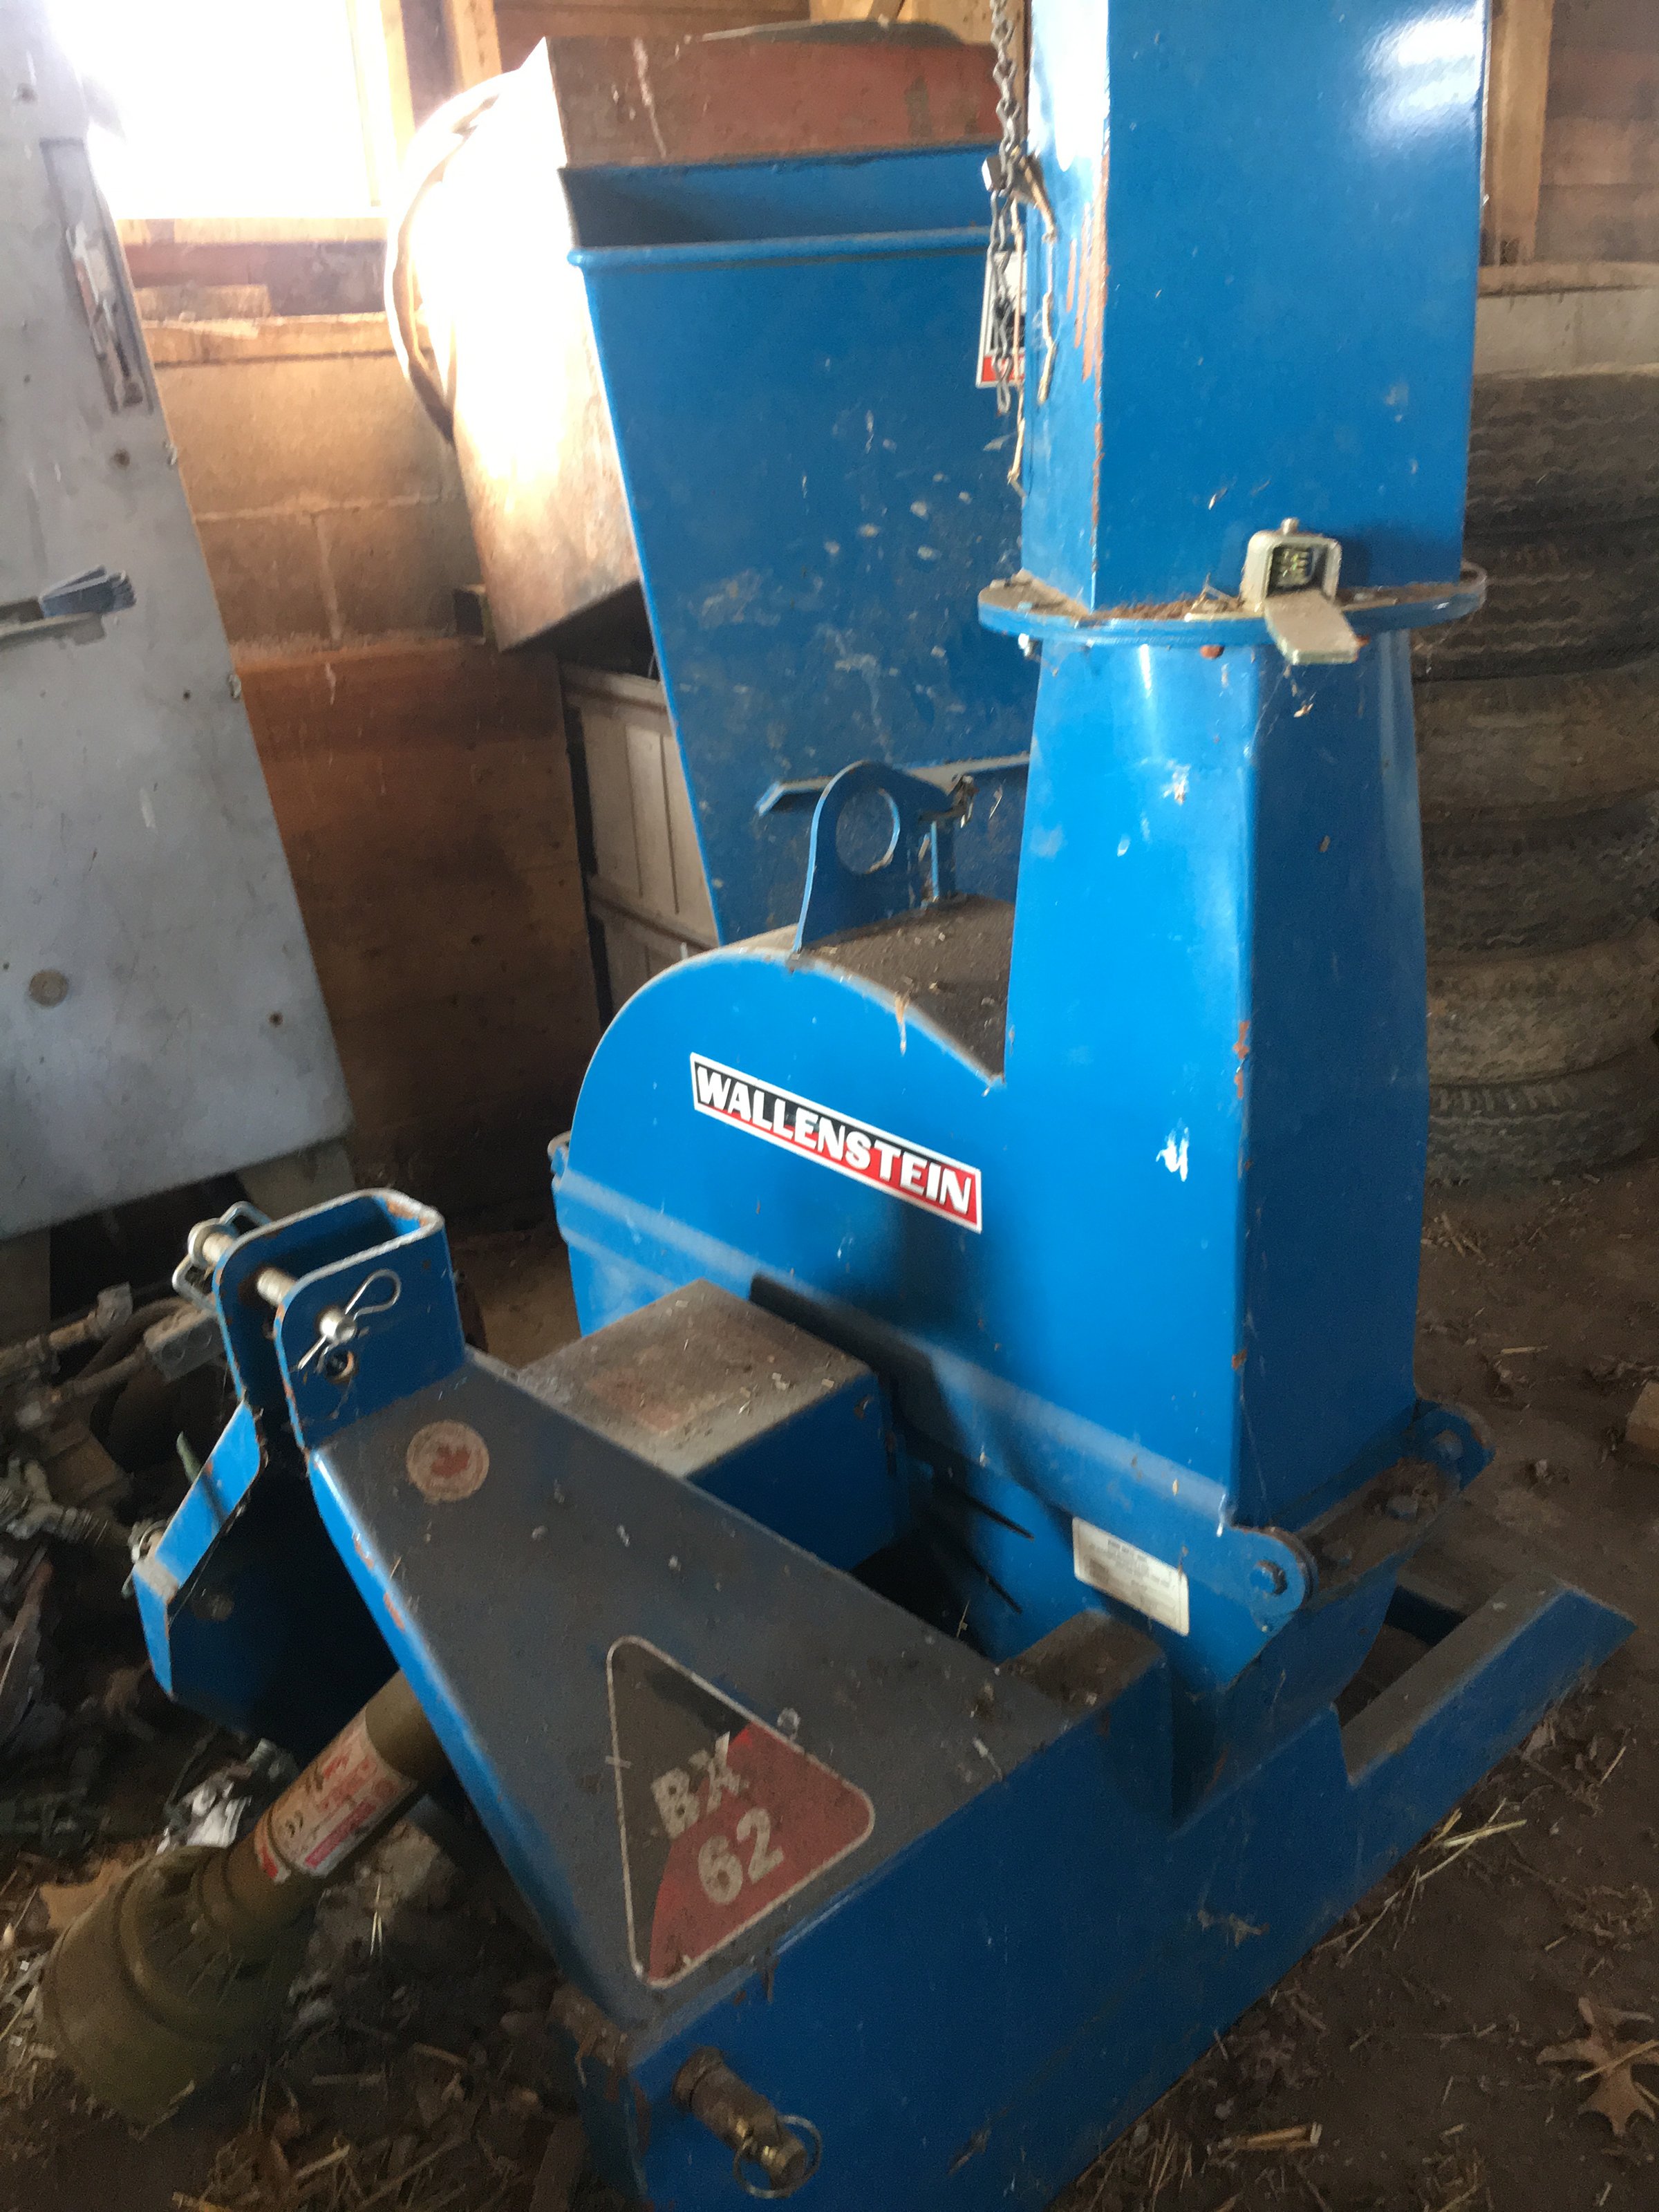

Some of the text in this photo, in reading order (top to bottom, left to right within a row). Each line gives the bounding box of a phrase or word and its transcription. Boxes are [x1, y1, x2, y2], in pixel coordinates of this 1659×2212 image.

[695, 1065, 972, 1215] WALLENSTEIN
[650, 1731, 745, 1839] BX
[697, 1808, 785, 1906] 62
